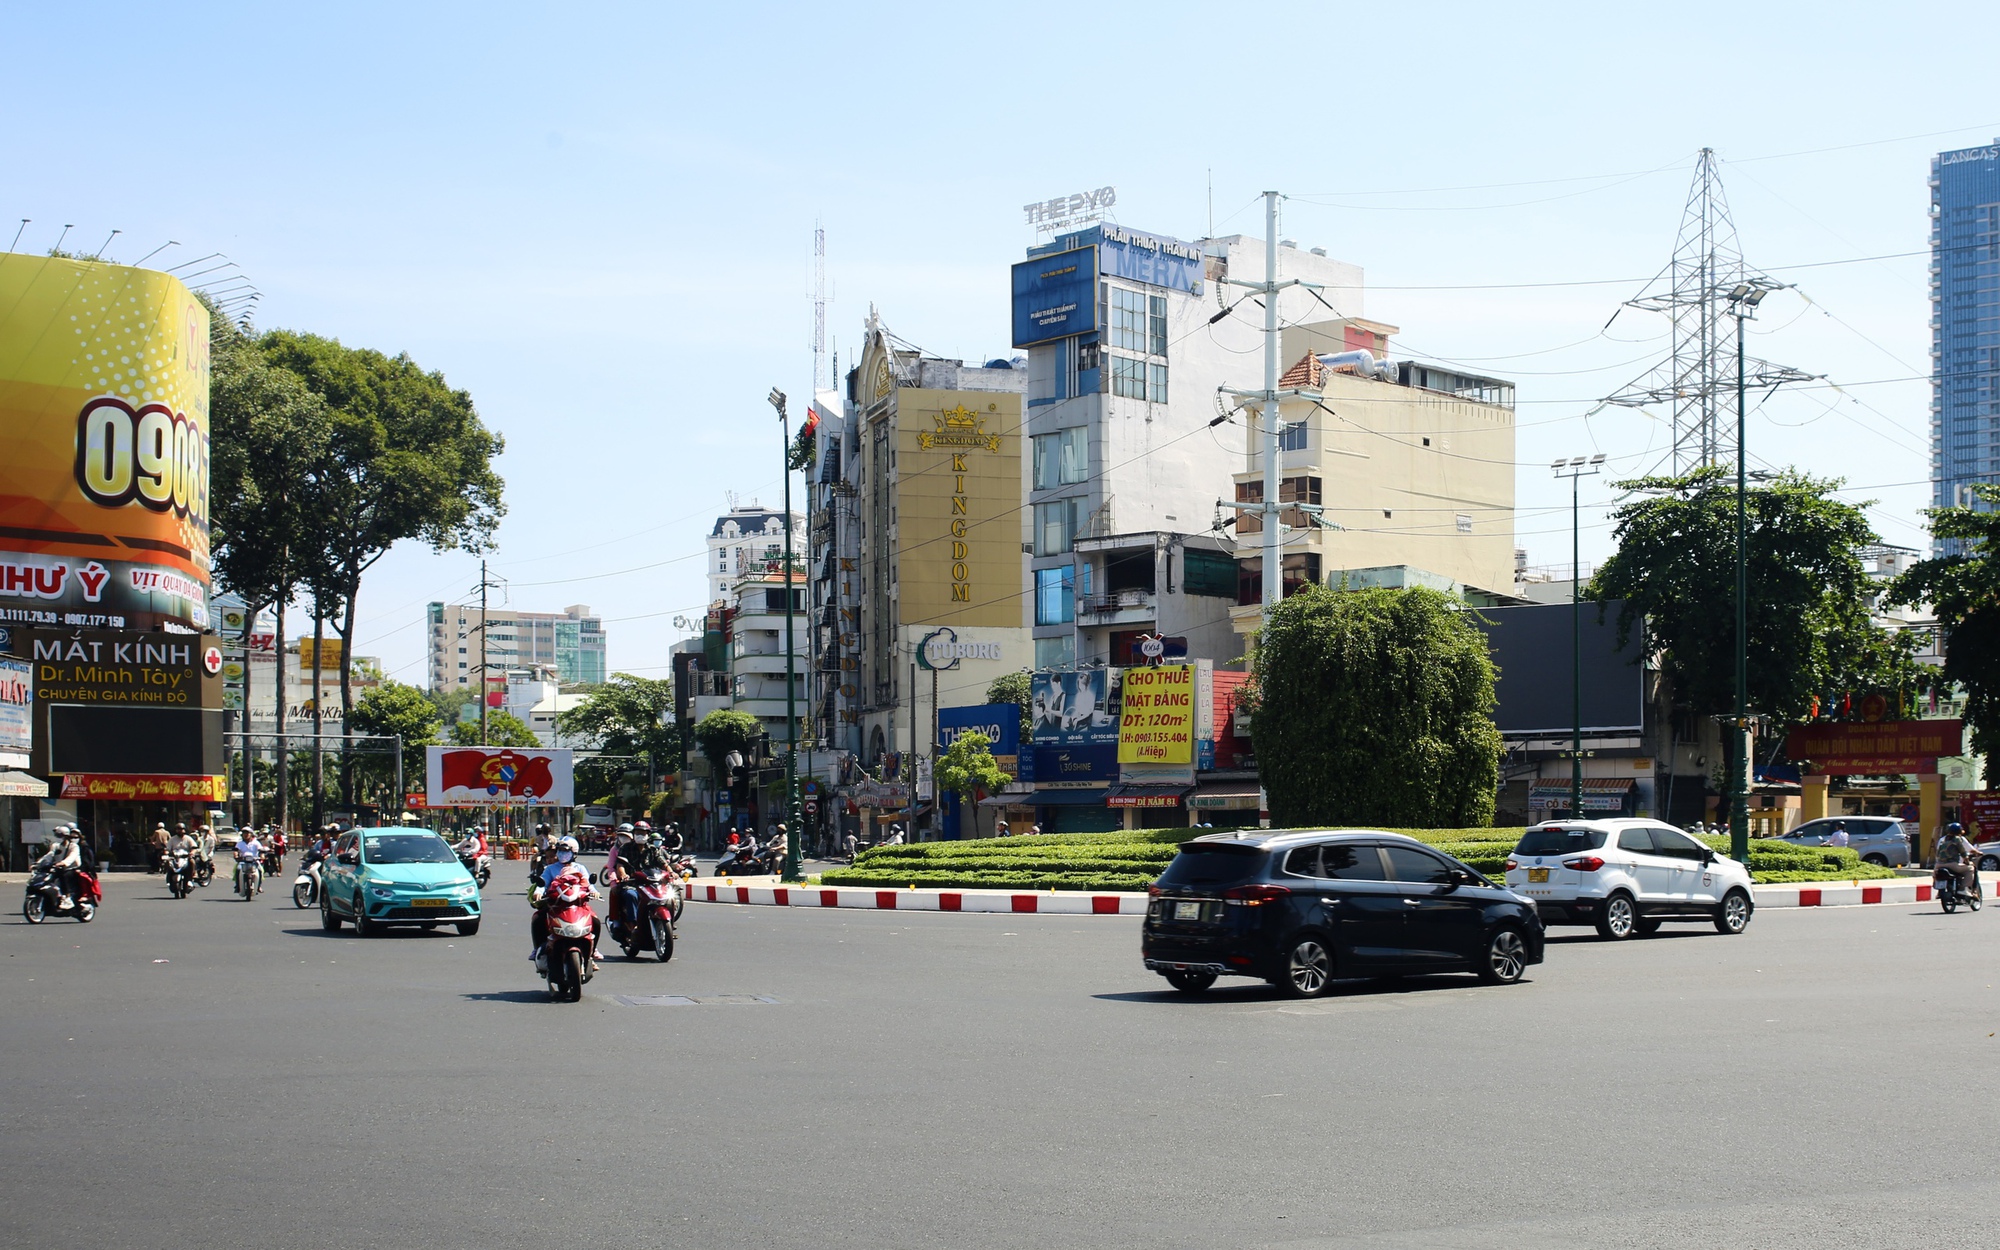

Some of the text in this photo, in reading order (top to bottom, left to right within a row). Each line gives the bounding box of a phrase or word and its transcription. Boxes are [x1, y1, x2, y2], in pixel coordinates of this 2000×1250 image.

[1941, 145, 2000, 166] LANCAS
[934, 436, 984, 446] KINGDOM
[951, 453, 970, 602] KINGDOM
[79, 565, 105, 597] Ý
[132, 571, 160, 590] VỊT
[163, 574, 183, 593] QUAY
[184, 580, 191, 597] DA
[33, 630, 190, 665] MẮT KÍNH
[929, 640, 1001, 660] TUBORG
[141, 667, 182, 688] Tây
[1127, 669, 1190, 686] CHO THUÊ
[38, 687, 187, 705] CHUYÊN GIA KÍNH ĐỘ
[1125, 689, 1189, 711] MẶT BẰNG
[1122, 714, 1145, 727] DT:
[1121, 732, 1134, 744] LH:
[1135, 732, 1188, 744] 0903.155.404
[1920, 736, 1943, 752] NAM
[183, 780, 213, 796] 2026
